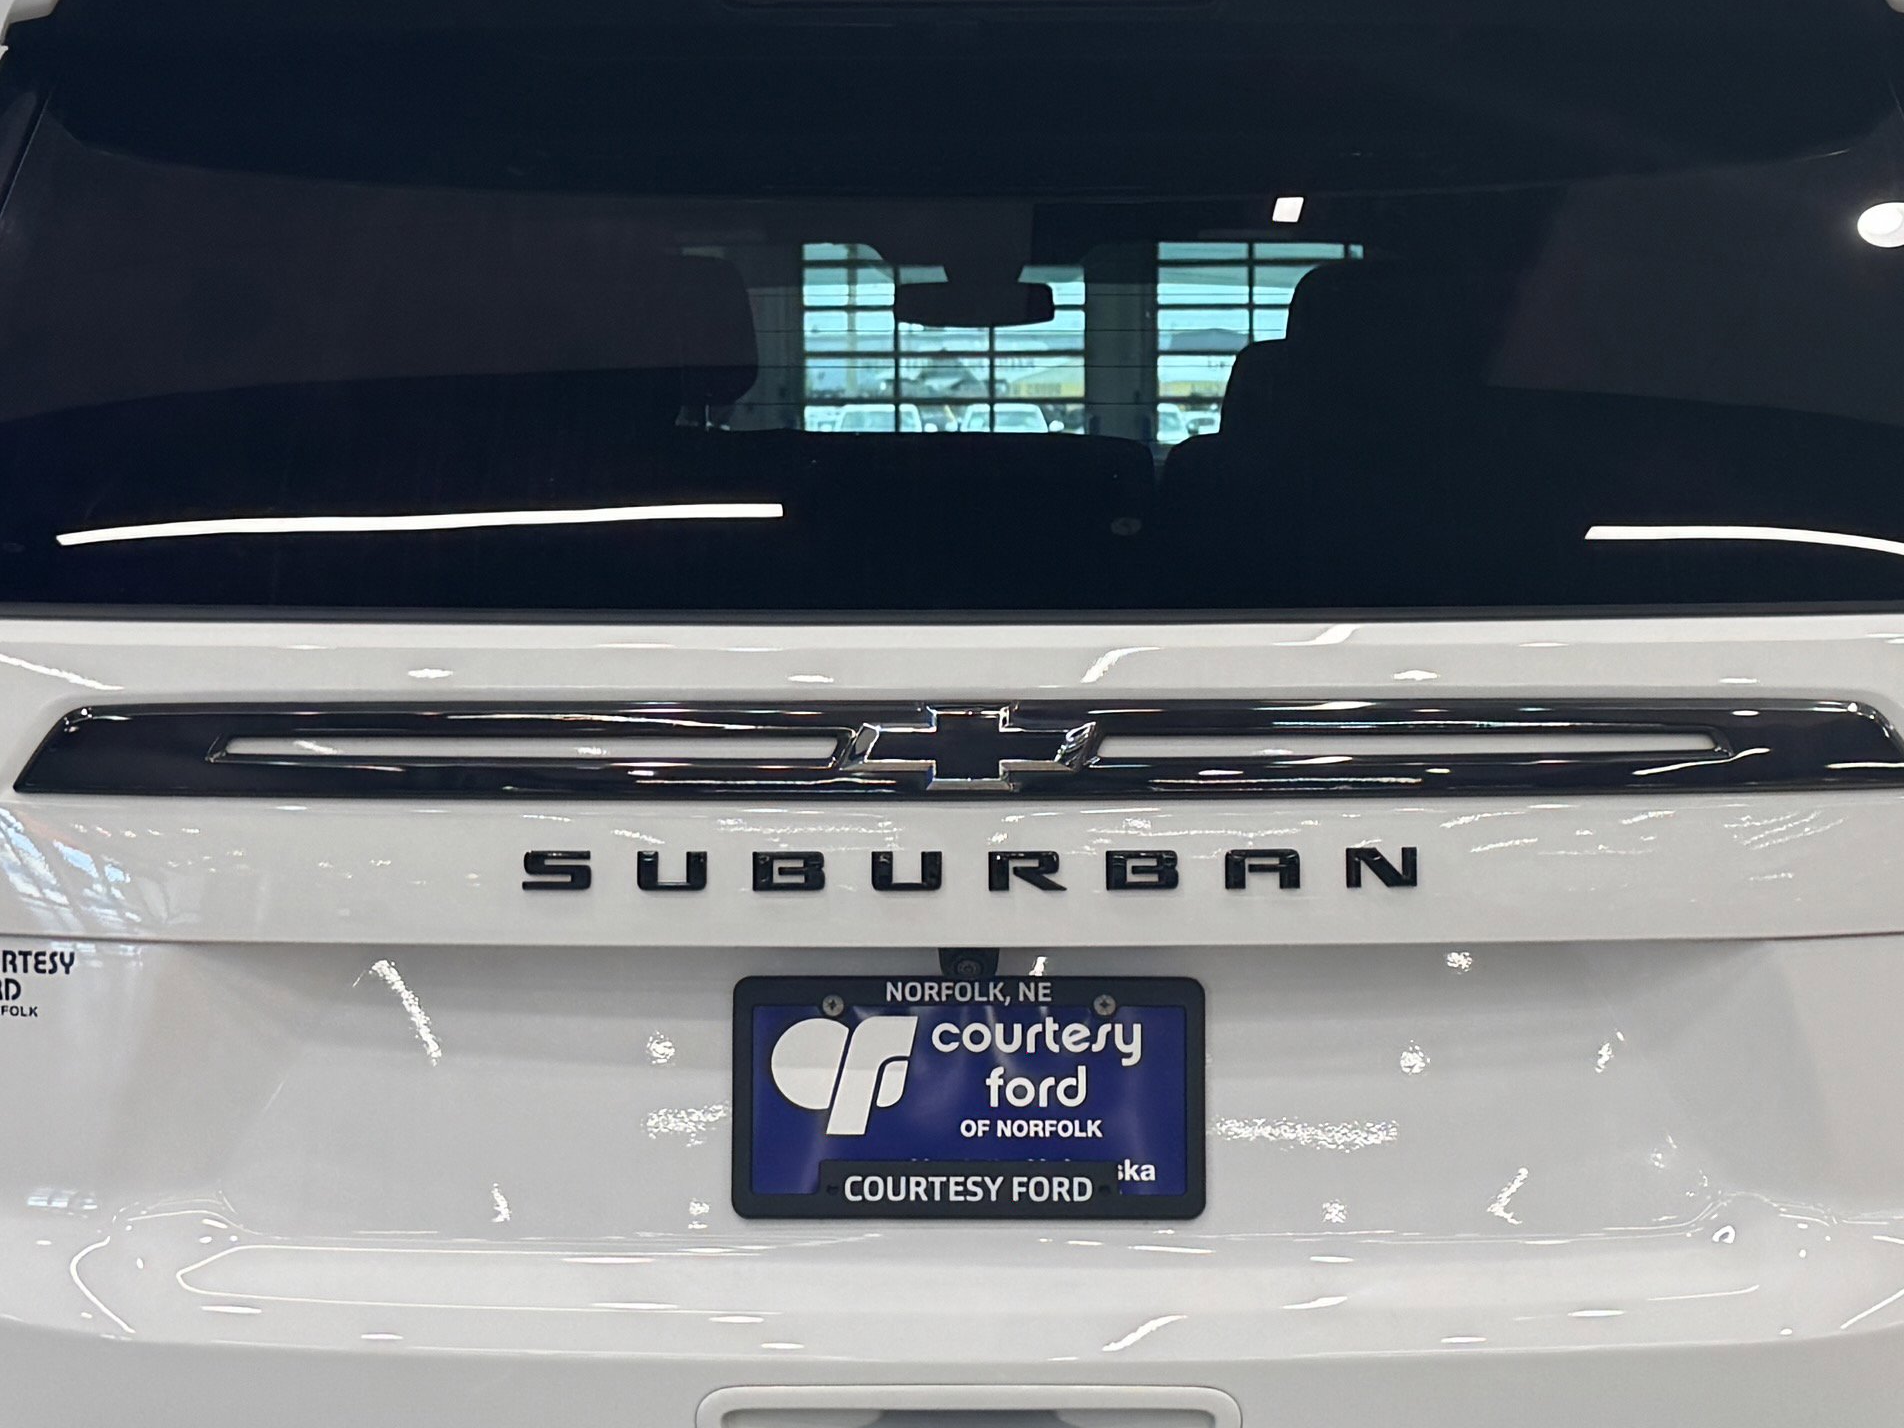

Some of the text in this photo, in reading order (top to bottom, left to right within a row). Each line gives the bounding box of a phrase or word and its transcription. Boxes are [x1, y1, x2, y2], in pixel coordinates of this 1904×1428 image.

[520, 845, 1419, 894] SUBURBAN
[885, 981, 1052, 1007] NORFOLK, NE
[931, 1018, 1142, 1067] courtesy
[985, 1065, 1088, 1108] ford
[960, 1118, 1103, 1138] OF NORFOLK
[844, 1175, 1094, 1203] COURTESY FORD
